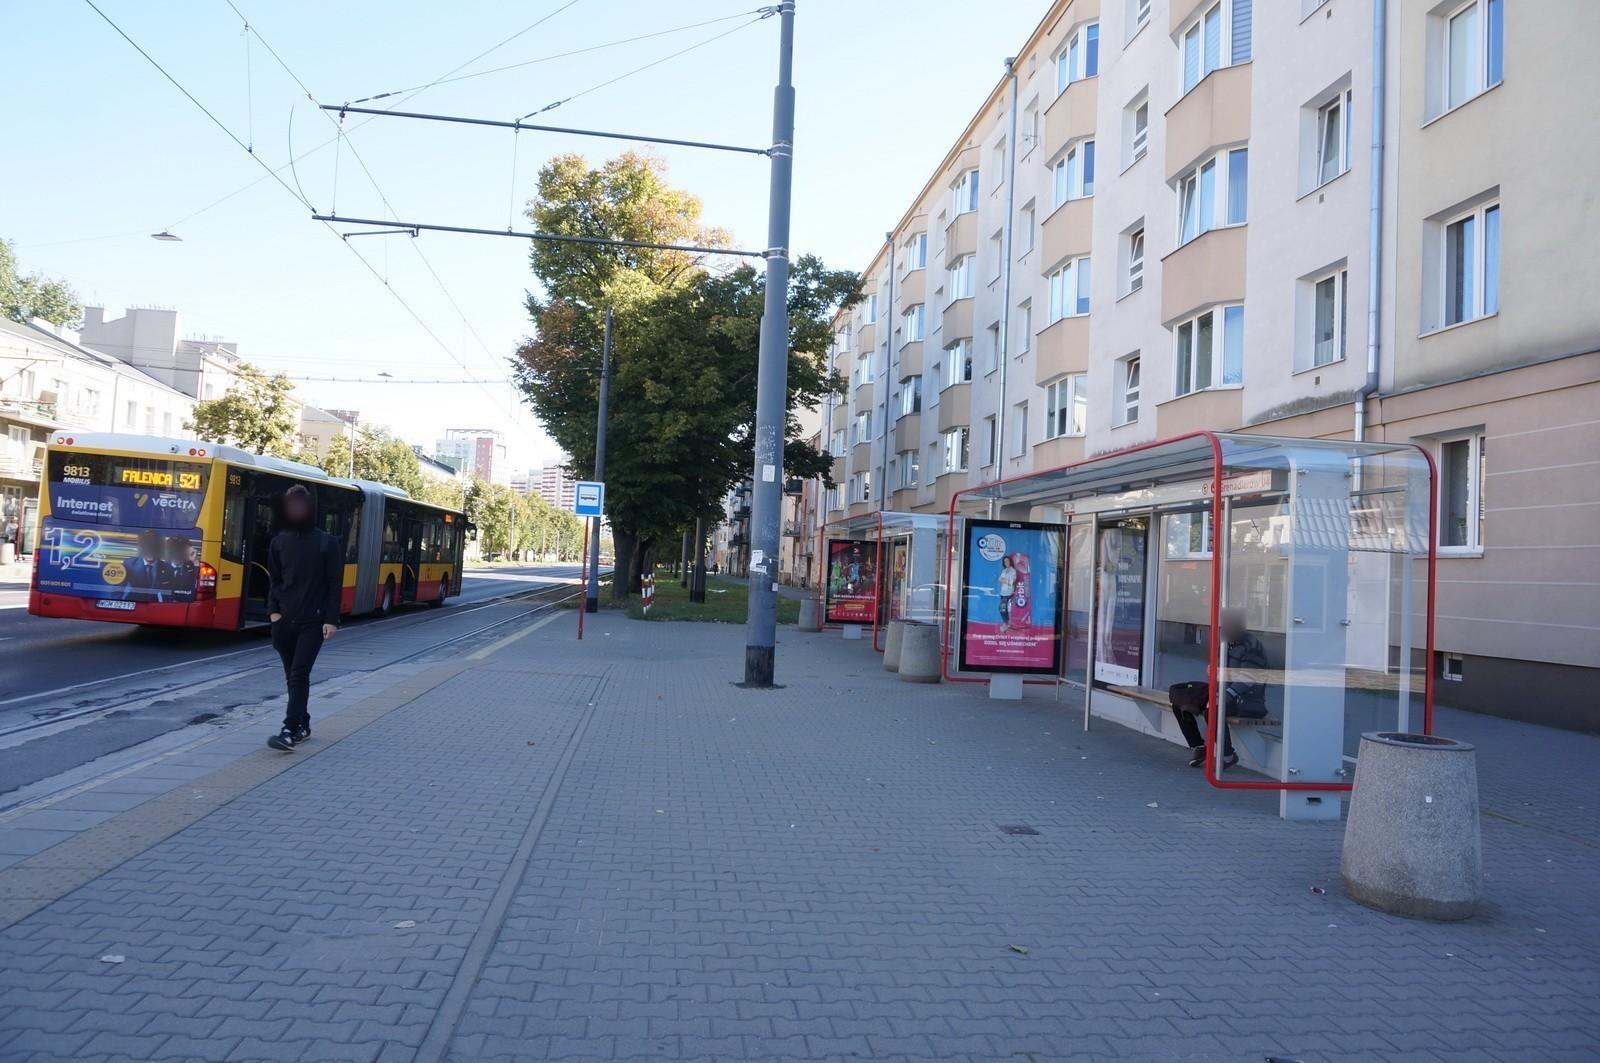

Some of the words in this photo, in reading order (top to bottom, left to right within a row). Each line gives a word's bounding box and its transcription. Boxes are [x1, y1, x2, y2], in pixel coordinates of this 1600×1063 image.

[64, 465, 90, 477] 9813
[122, 469, 173, 486] FALENICA
[179, 473, 200, 489] 521
[63, 477, 91, 485] MOBILIS
[57, 496, 113, 512] Internet
[45, 527, 102, 570] 1,2
